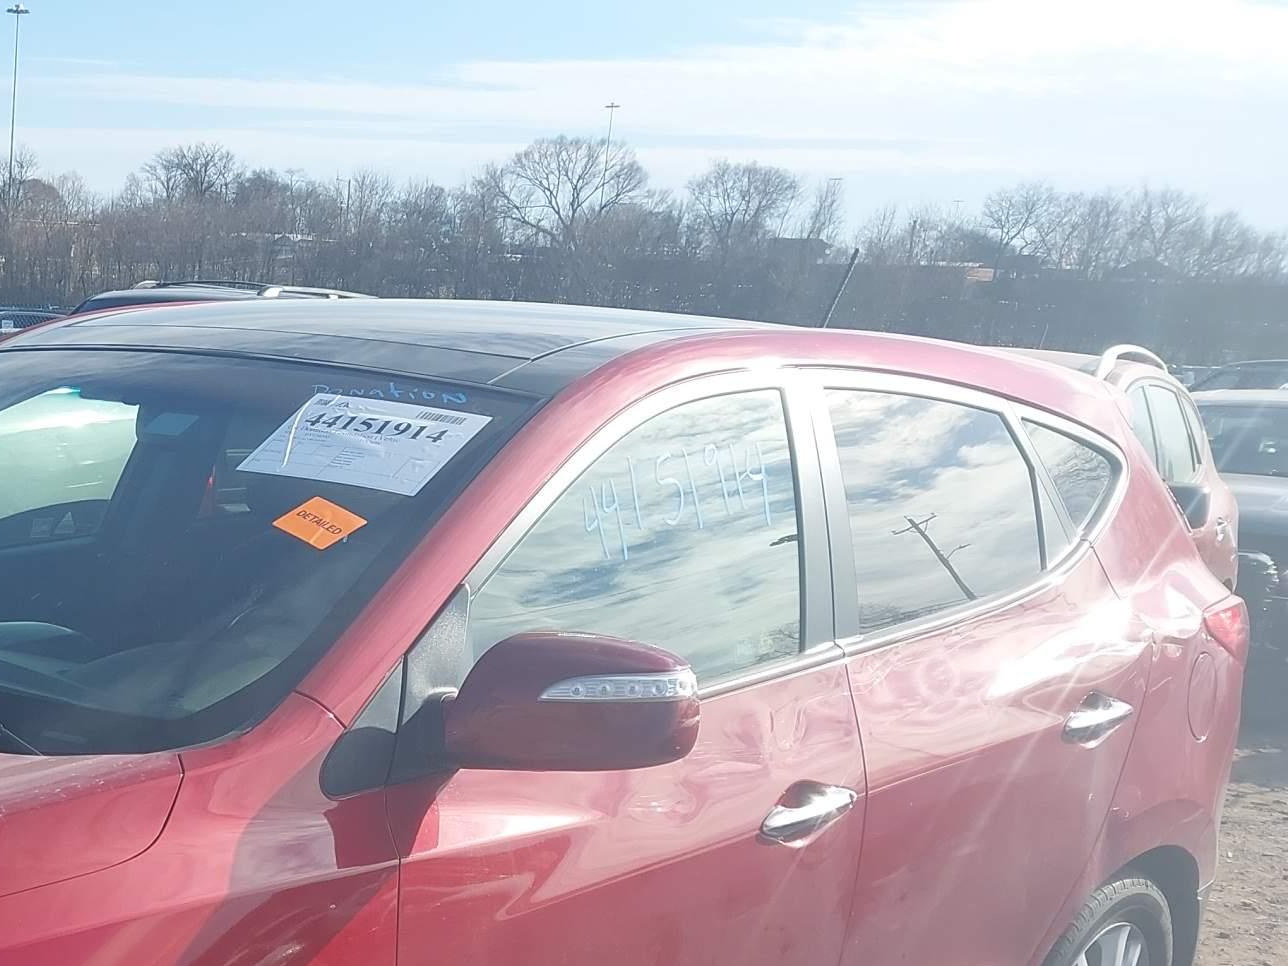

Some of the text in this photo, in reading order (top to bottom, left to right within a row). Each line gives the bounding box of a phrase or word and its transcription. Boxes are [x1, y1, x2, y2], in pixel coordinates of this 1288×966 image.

[304, 411, 450, 444] 44151914
[582, 440, 772, 561] 44151914
[295, 509, 343, 535] DETAILED
